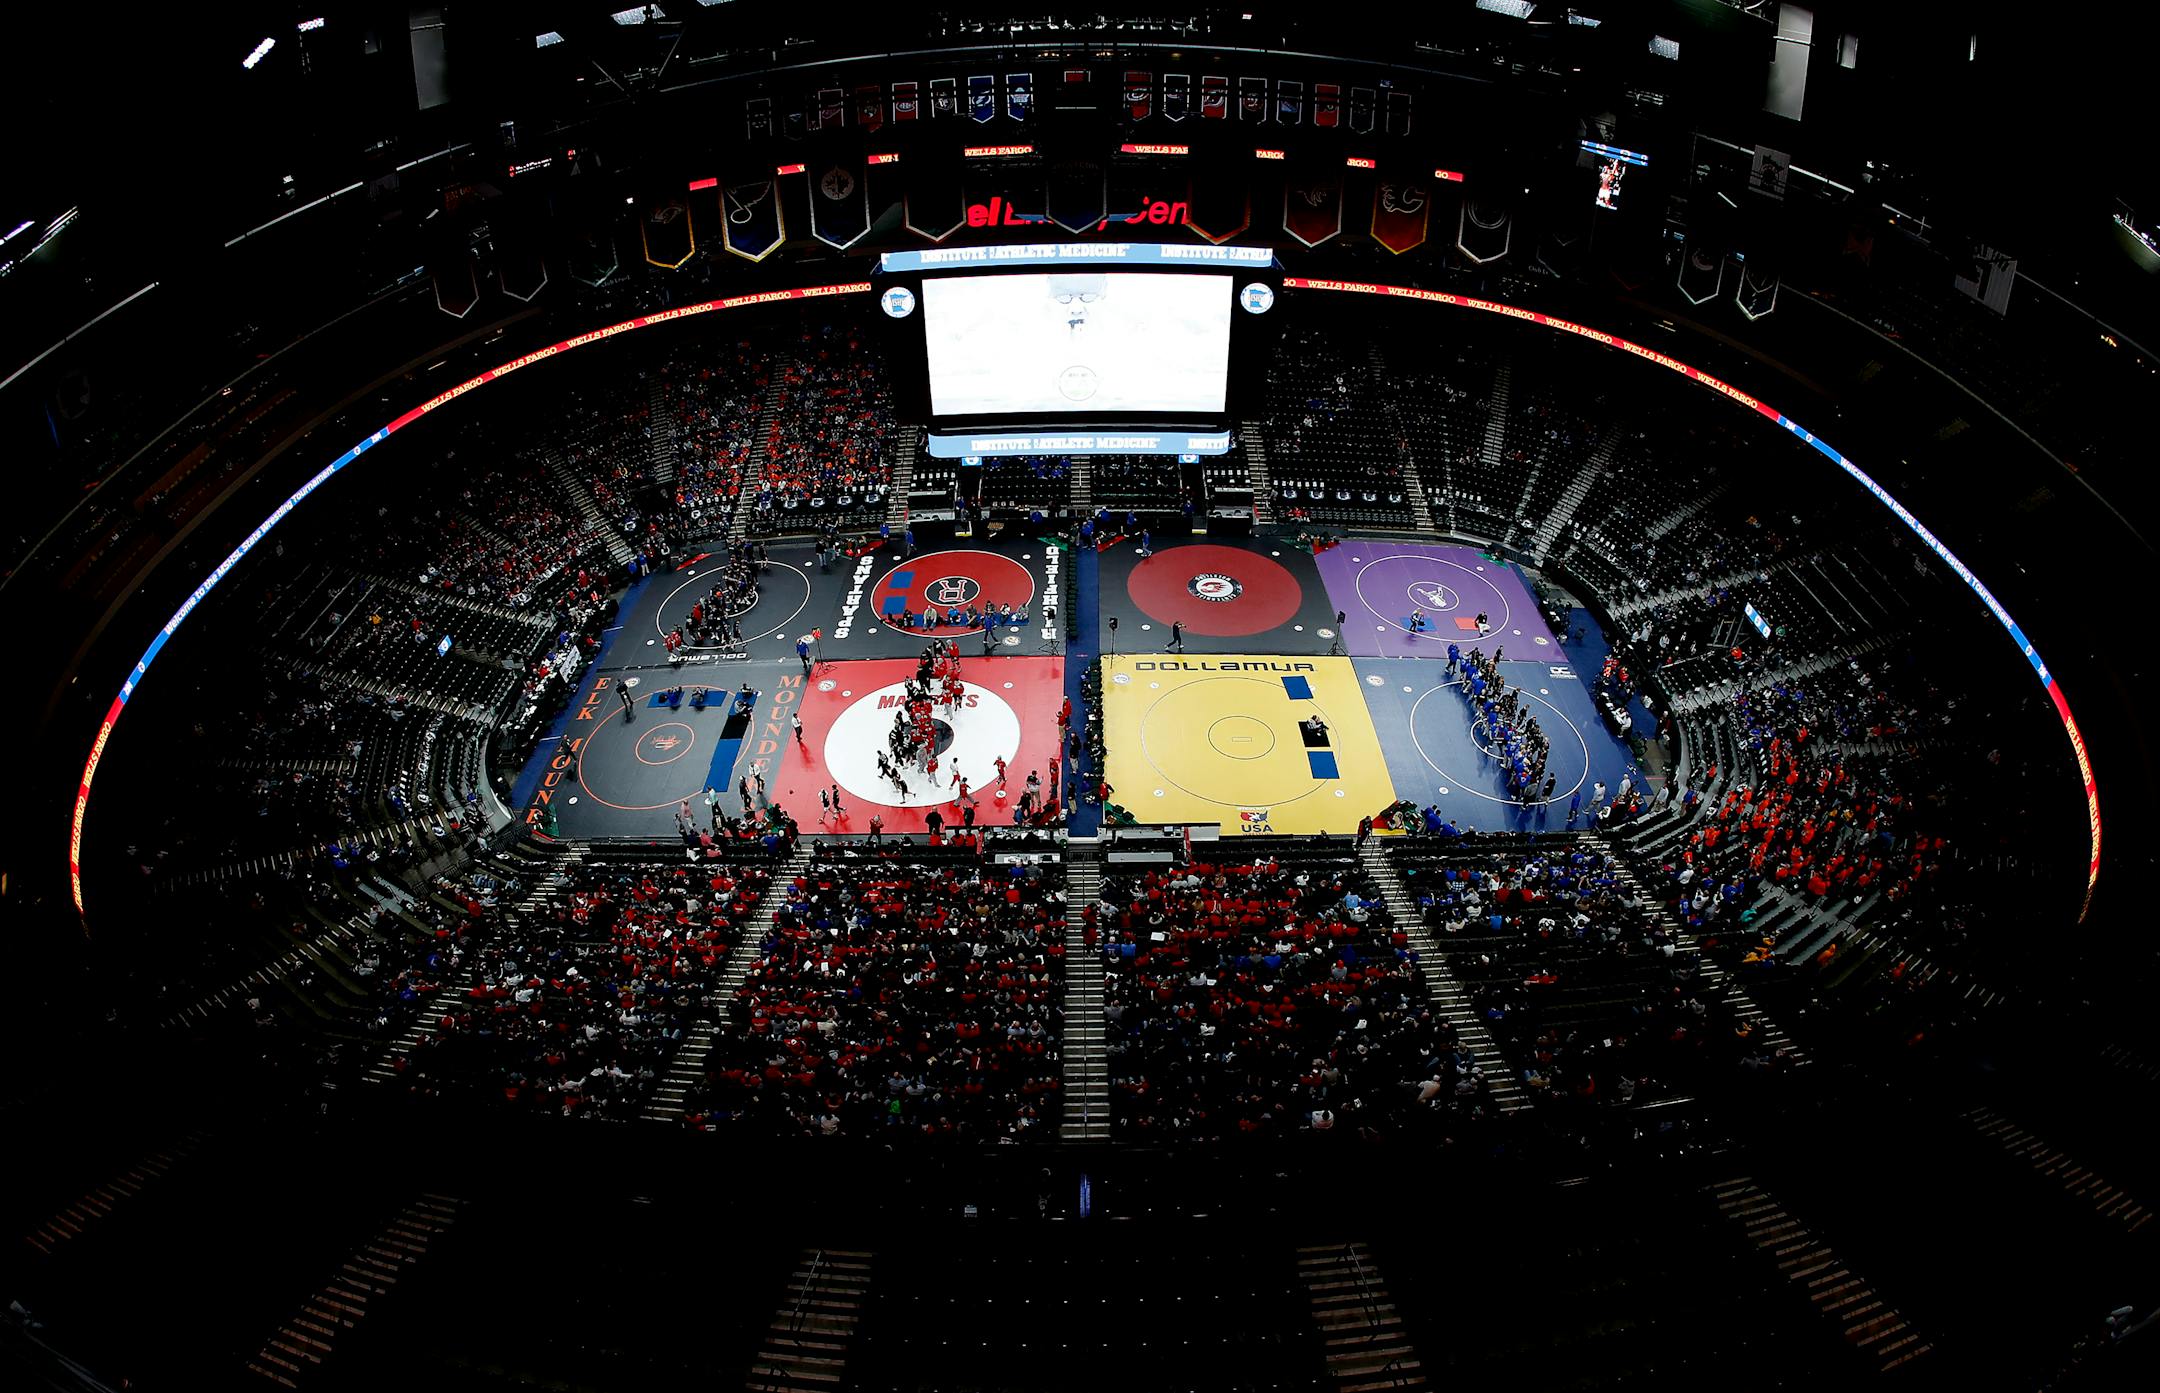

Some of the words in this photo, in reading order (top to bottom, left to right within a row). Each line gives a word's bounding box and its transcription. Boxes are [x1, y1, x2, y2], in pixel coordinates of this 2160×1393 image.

[965, 147, 997, 157] WELLS
[999, 145, 1032, 155] FARGO
[1135, 145, 1169, 154] WELLS
[921, 247, 986, 263] INSTITUTE
[1161, 244, 1226, 260] INSTITUTE
[802, 286, 836, 297] WELLS
[838, 283, 871, 293] FARGO
[1307, 280, 1342, 291] WELLS
[1344, 282, 1377, 293] FARGO
[1388, 286, 1421, 299] WELLS
[1423, 291, 1456, 304] FARGO
[723, 295, 757, 308] WELLS
[759, 291, 792, 302] FARGO
[1467, 299, 1501, 313] WELLS
[1502, 306, 1535, 321] FARGO
[644, 310, 678, 324] WELLS
[680, 303, 713, 316] FARGO
[567, 331, 601, 348] WELLS
[602, 321, 635, 338] FARGO
[1545, 317, 1579, 334] WELLS
[1580, 327, 1613, 344] FARGO
[492, 357, 525, 378] WELLS
[526, 346, 557, 365] FARGO
[1623, 341, 1656, 361] WELLS
[1656, 354, 1687, 374] FARGO
[421, 391, 453, 413] WELLS
[453, 377, 484, 398] FARGO
[1696, 372, 1728, 394] WELLS
[1728, 387, 1758, 409] FARGO
[971, 438, 1031, 451] INSTITUTE
[833, 555, 874, 640] SPARTANS
[1971, 576, 2014, 629] Tournament
[164, 596, 197, 635] Welcome
[195, 588, 206, 600] to
[576, 677, 611, 720] ELK
[1241, 824, 1274, 833] USA
